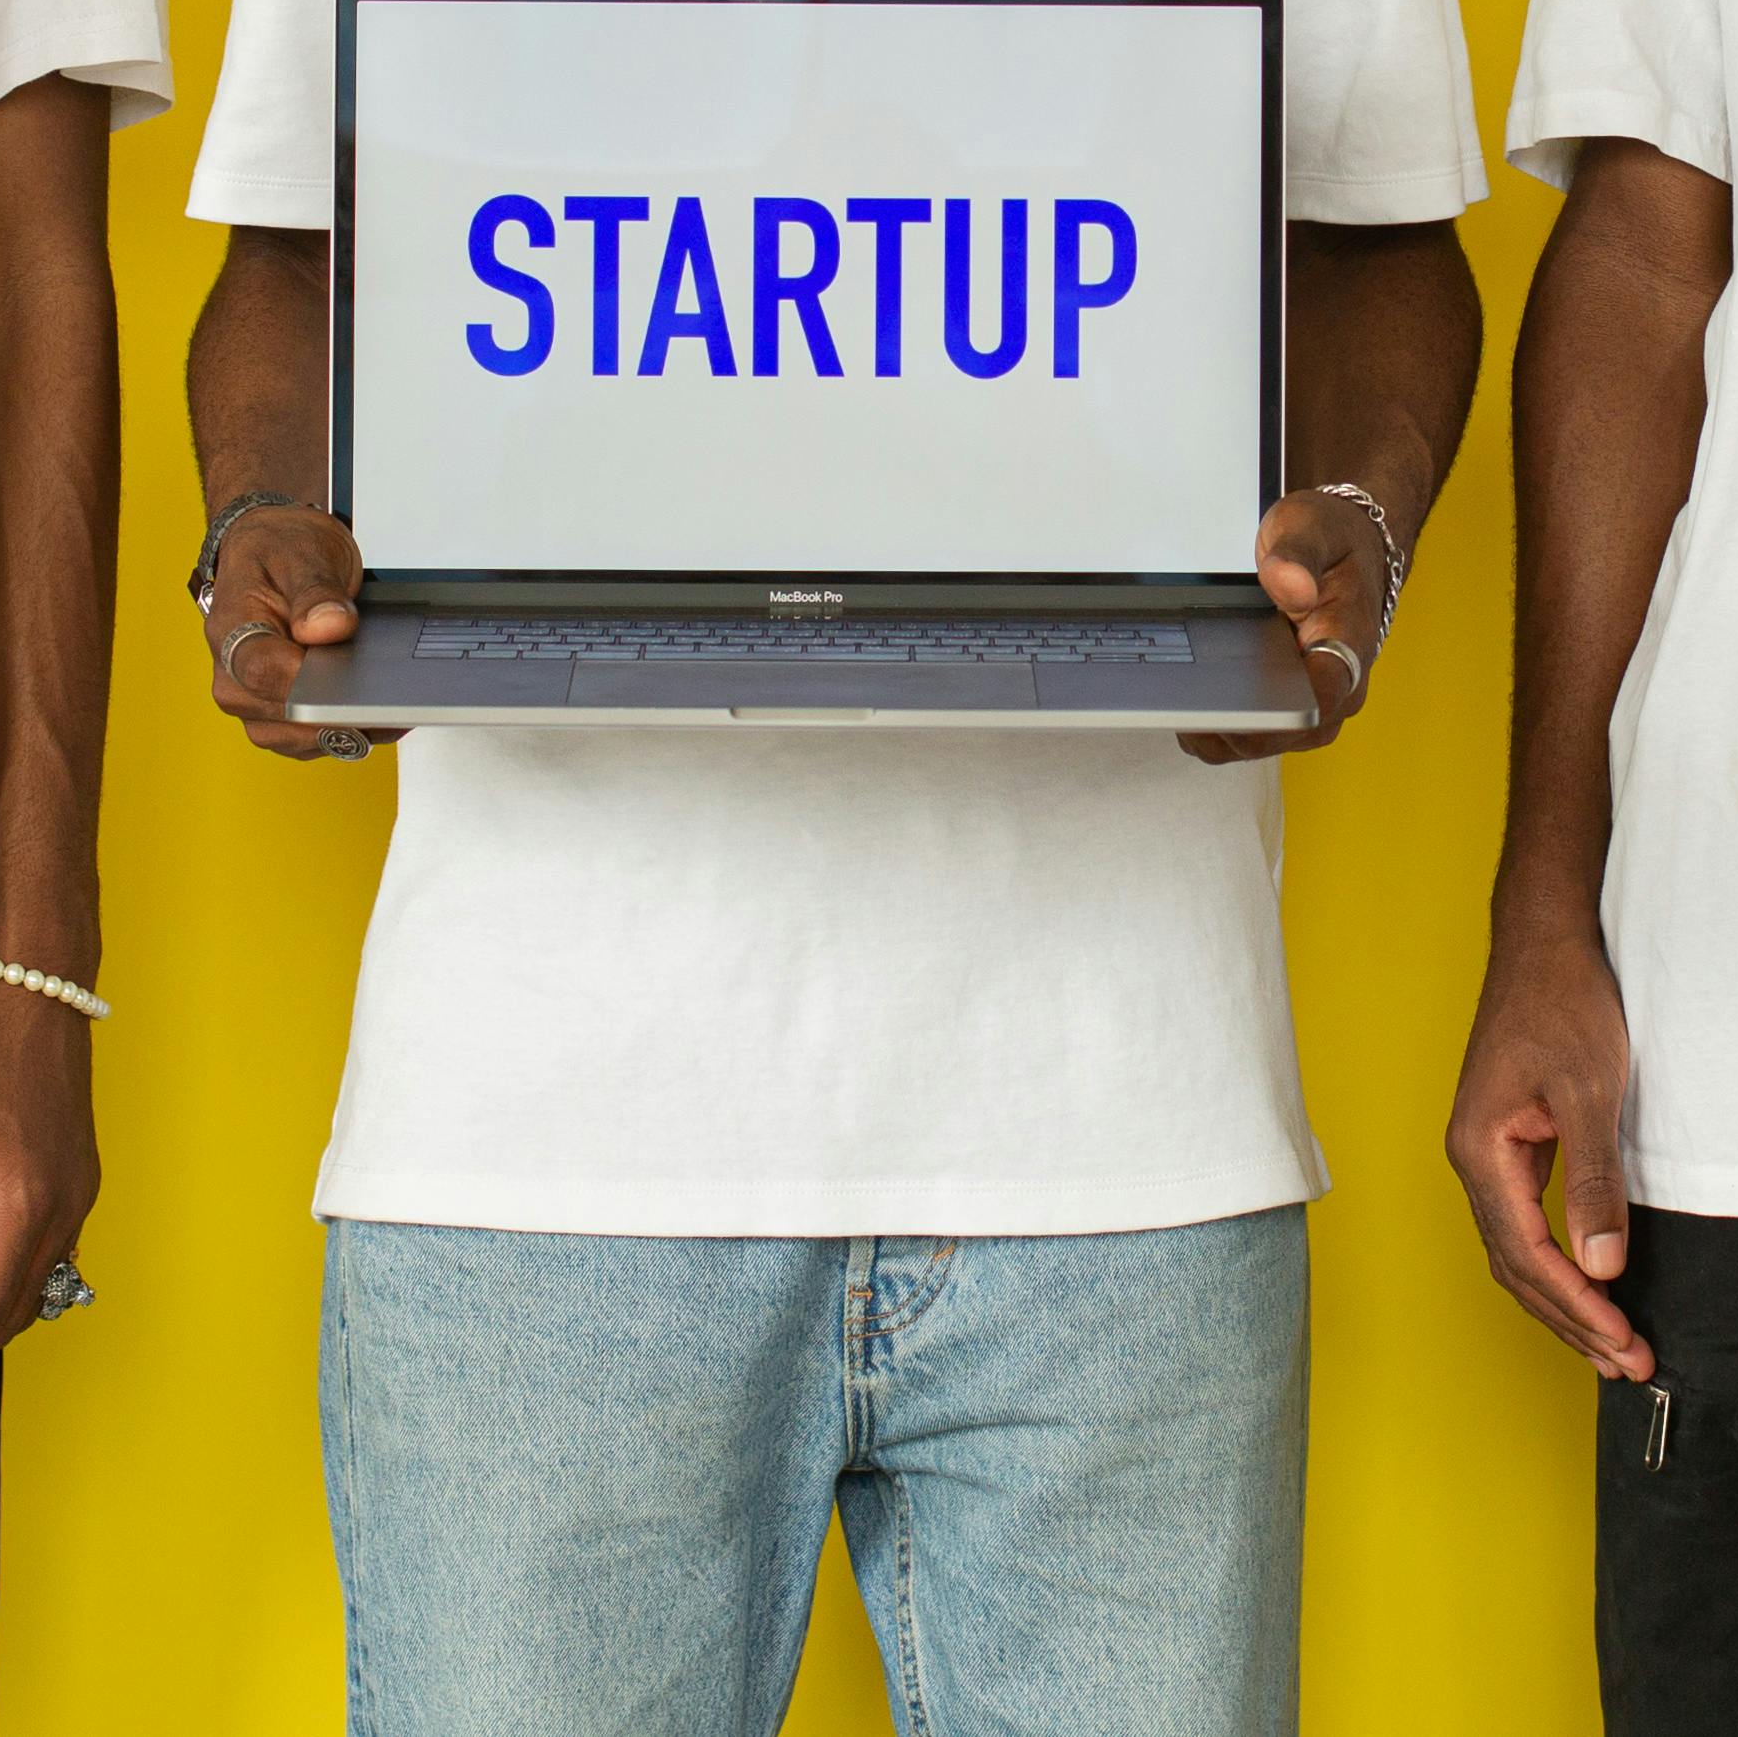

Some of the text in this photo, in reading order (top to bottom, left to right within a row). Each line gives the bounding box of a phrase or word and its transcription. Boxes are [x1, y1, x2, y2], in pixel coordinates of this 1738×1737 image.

[465, 193, 1138, 380] STARTUP
[769, 590, 843, 603] MacBook Pro
